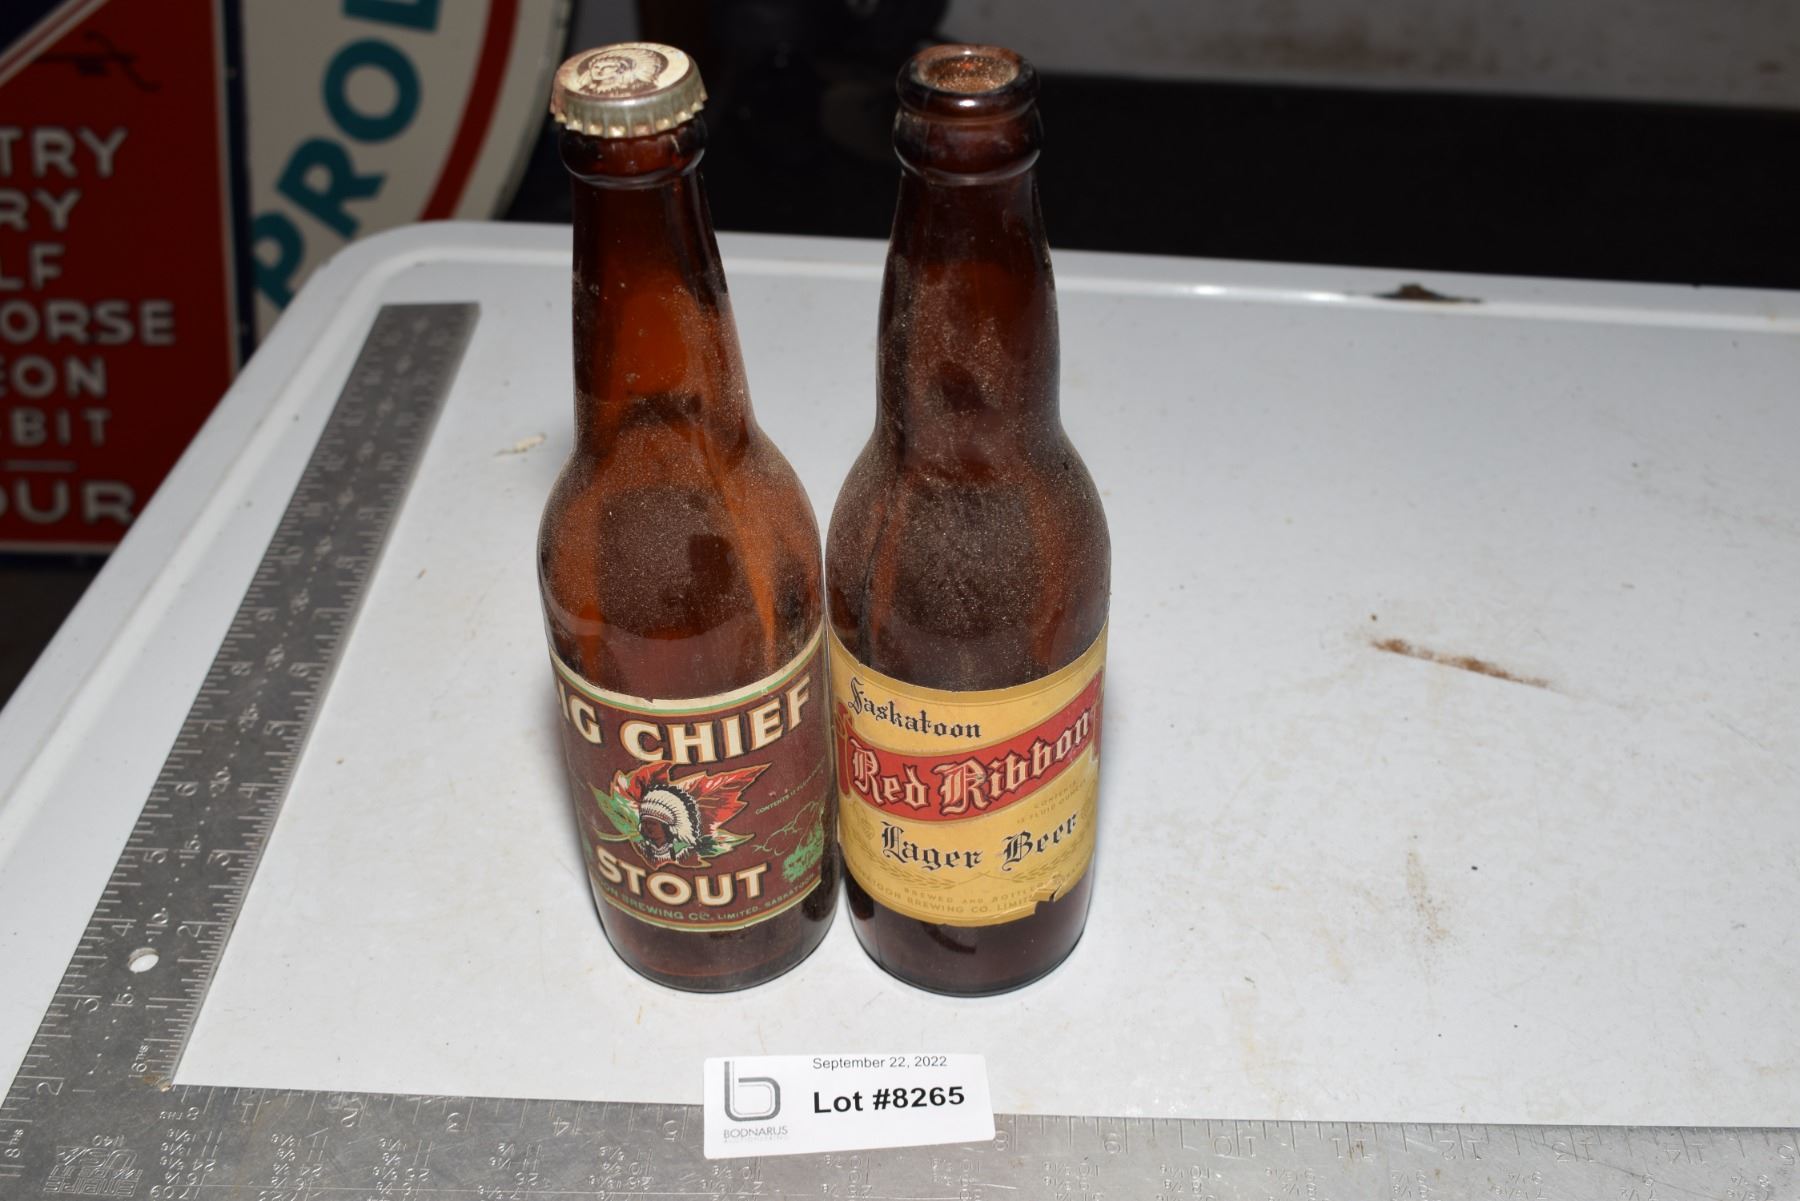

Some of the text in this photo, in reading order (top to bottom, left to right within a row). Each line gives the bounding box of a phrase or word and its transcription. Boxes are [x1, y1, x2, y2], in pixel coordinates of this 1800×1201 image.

[848, 676, 982, 739] Saskatoon
[620, 674, 812, 765] CHIEF
[263, 723, 286, 737] 5
[849, 705, 1093, 816] Red Ribbon
[174, 783, 198, 797] 6
[237, 787, 259, 799] 4
[880, 810, 1079, 872] Lager Beer
[143, 850, 167, 865] 5
[206, 853, 231, 867] 3
[596, 846, 768, 906] STOUT
[621, 893, 684, 920] BREWING
[764, 872, 815, 909] SASKATOON
[904, 886, 954, 904] BREWED
[906, 896, 964, 914] BREWING
[111, 923, 134, 937] 4
[176, 924, 202, 938] 2
[73, 998, 100, 1014] 3
[812, 1056, 948, 1071] September 22, 2022
[36, 1081, 64, 1096] 2
[813, 1086, 966, 1114] Lot #8265
[341, 1107, 360, 1128] 2
[445, 1112, 466, 1133] 3
[551, 1116, 571, 1137] 4
[662, 1120, 680, 1142] 5
[723, 1126, 789, 1139] BODNARUS
[1104, 1131, 1122, 1155] 9
